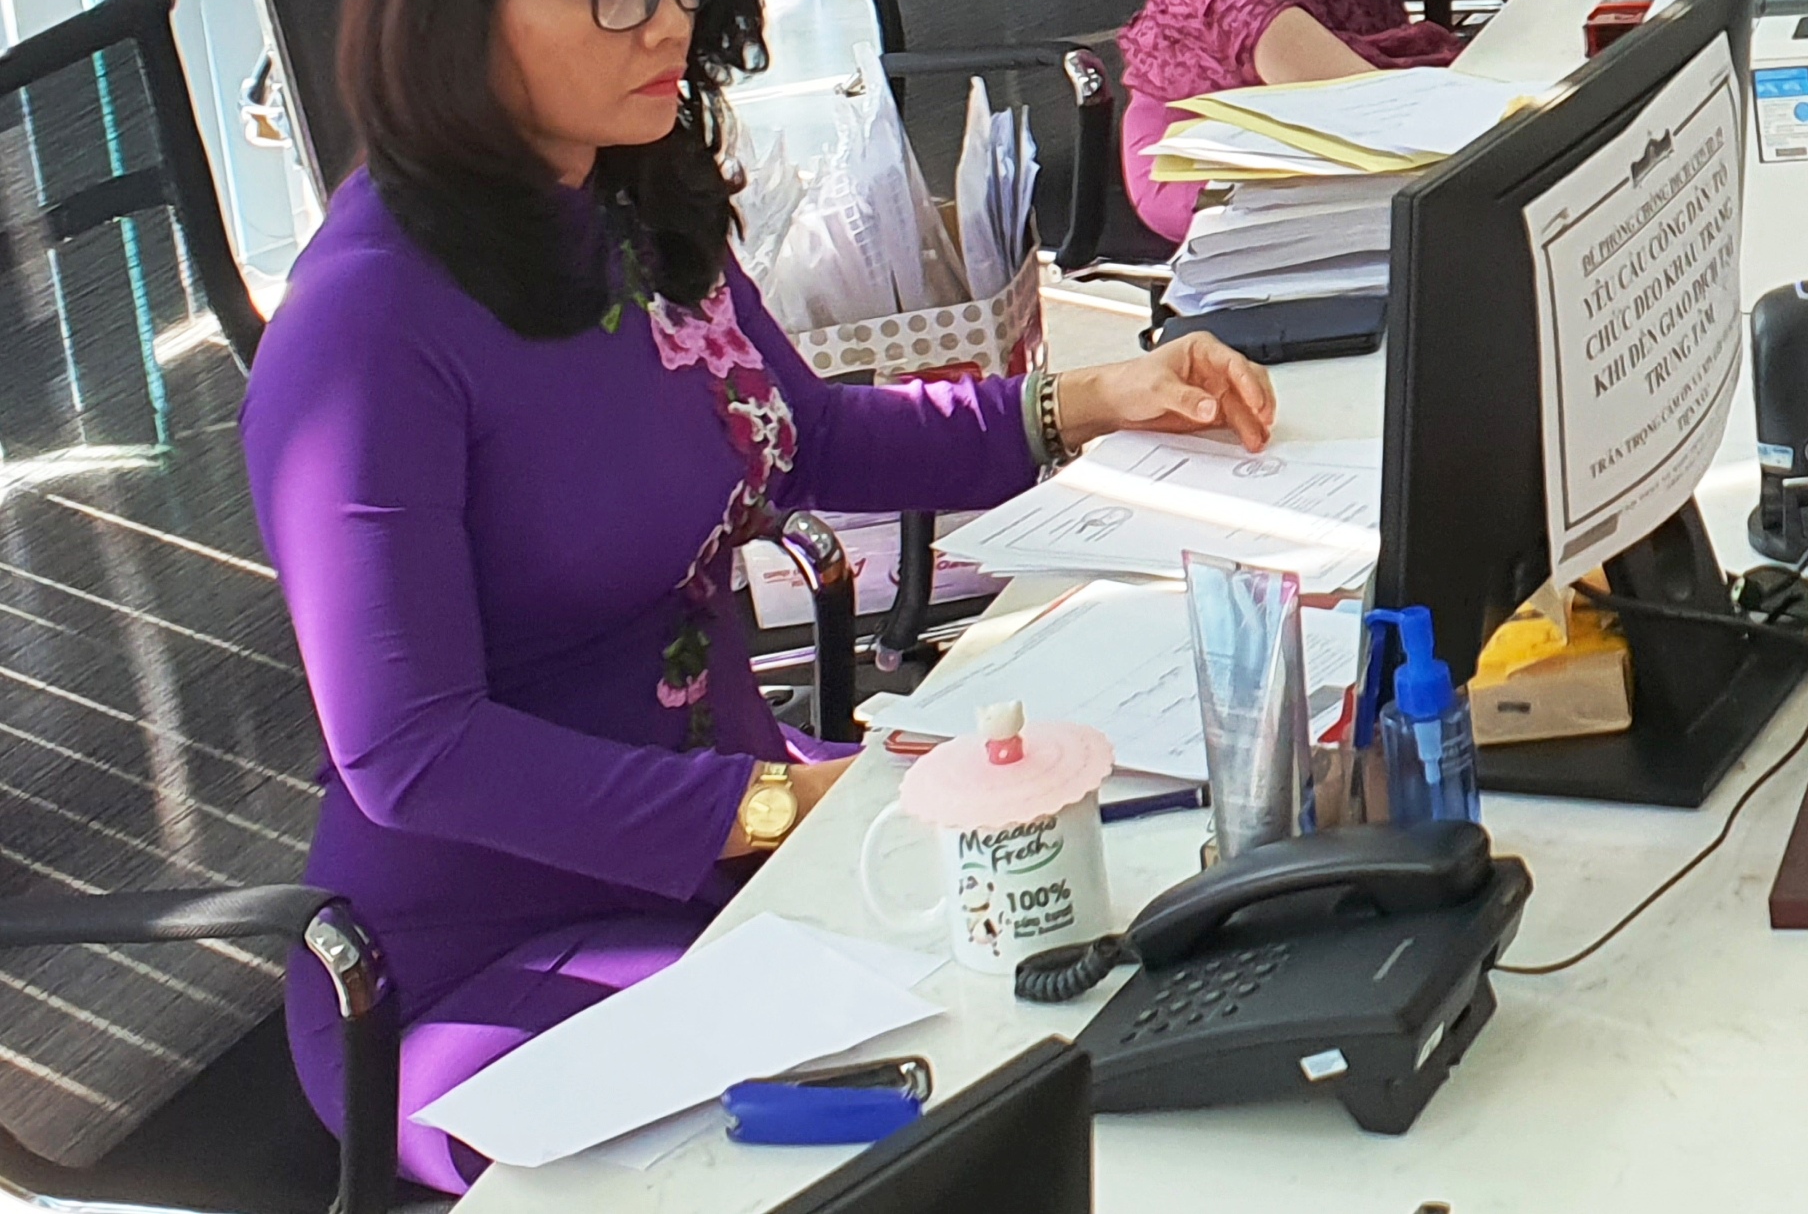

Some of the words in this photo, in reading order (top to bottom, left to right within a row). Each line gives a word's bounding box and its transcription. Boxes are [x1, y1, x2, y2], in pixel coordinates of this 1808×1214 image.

[1649, 209, 1686, 261] CÔNG
[991, 831, 1049, 873] Fresh
[1007, 878, 1071, 913] 100%
